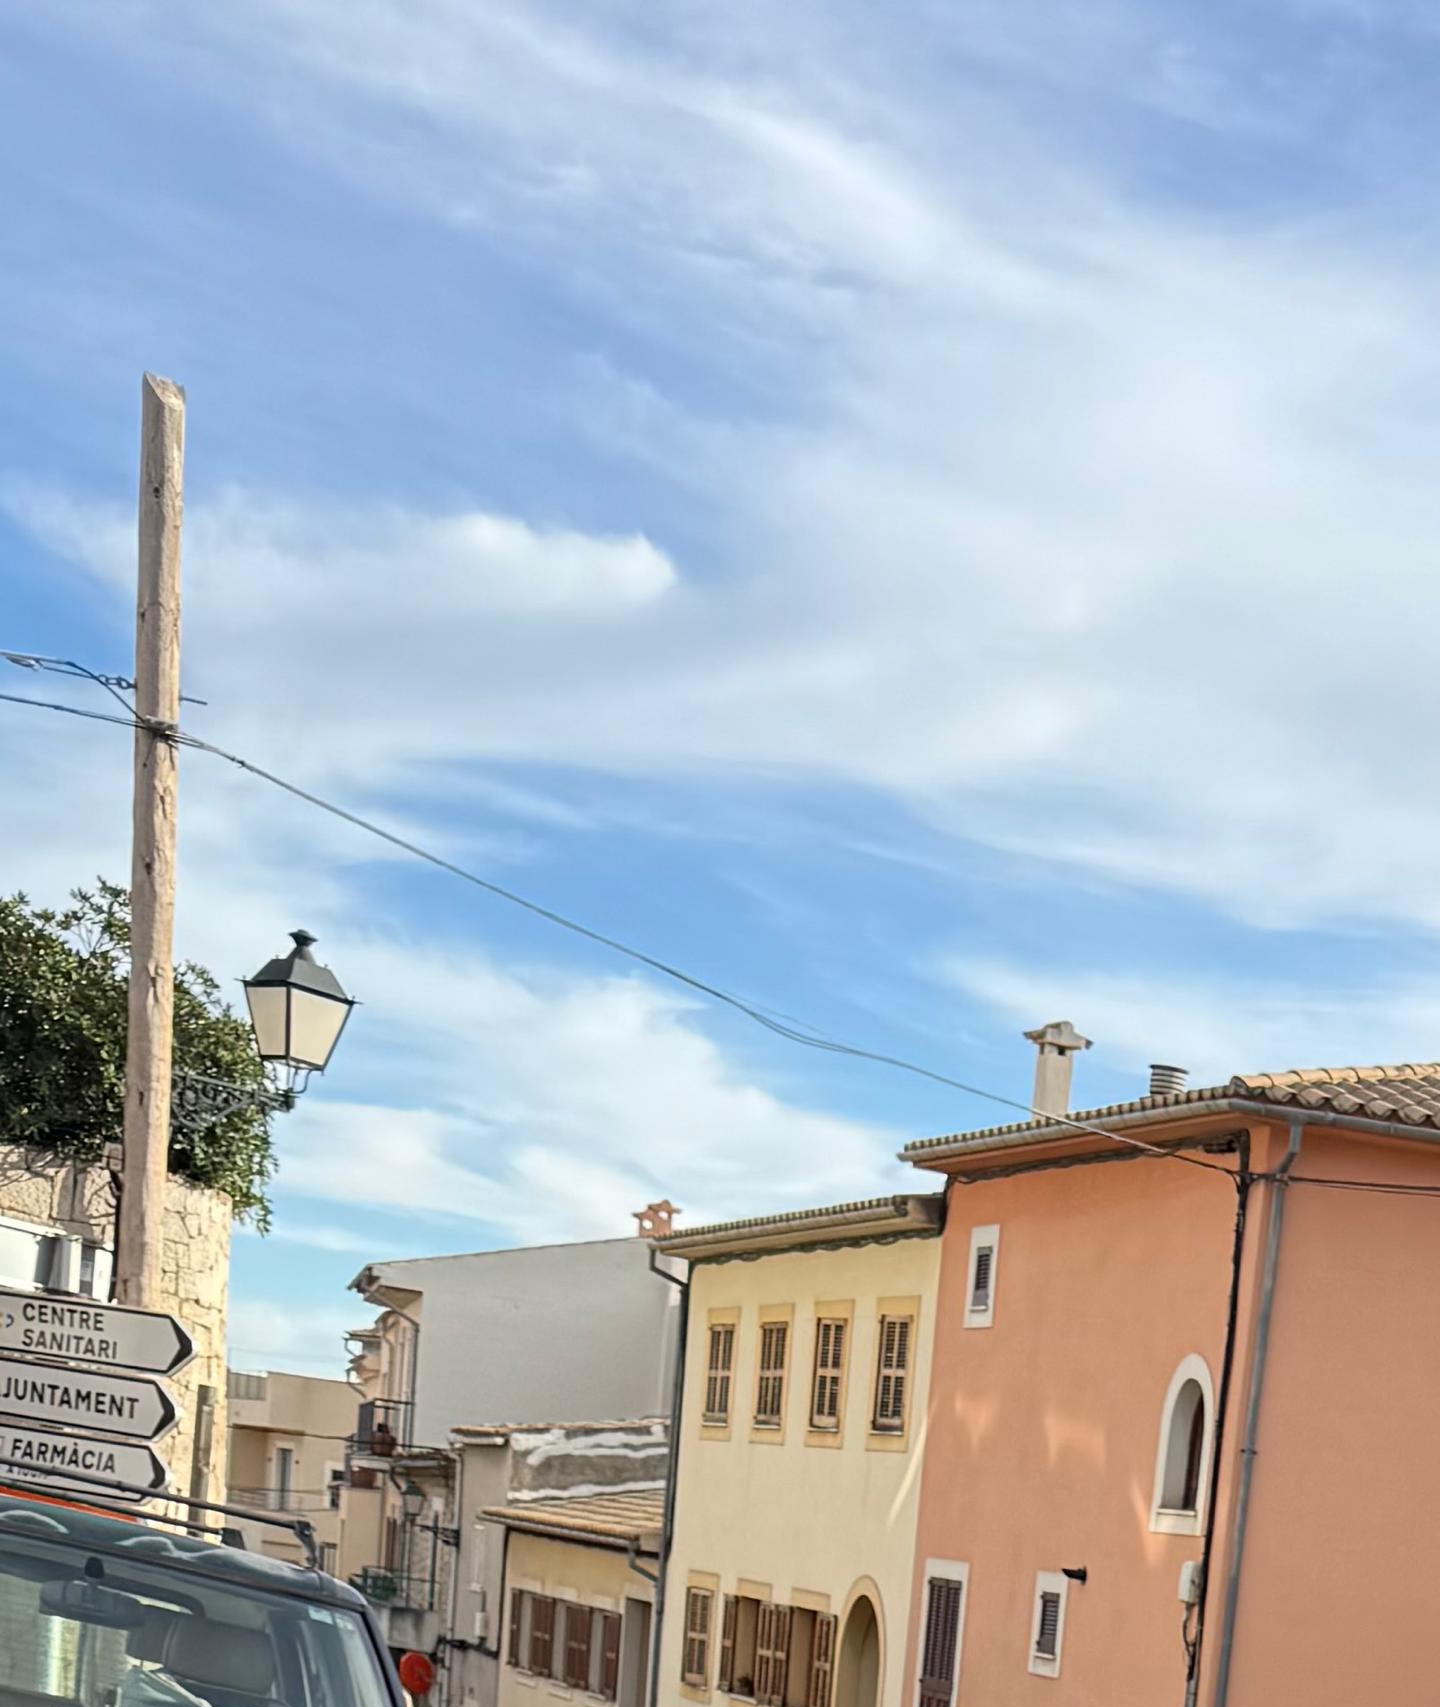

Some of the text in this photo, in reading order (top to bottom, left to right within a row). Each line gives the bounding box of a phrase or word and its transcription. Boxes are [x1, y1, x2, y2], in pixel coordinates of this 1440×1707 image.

[22, 1303, 104, 1331] CENTRE
[22, 1329, 118, 1359] SANITARI
[0, 1377, 139, 1419] JUNTAMENT
[11, 1438, 116, 1473] FARMÀCIA
